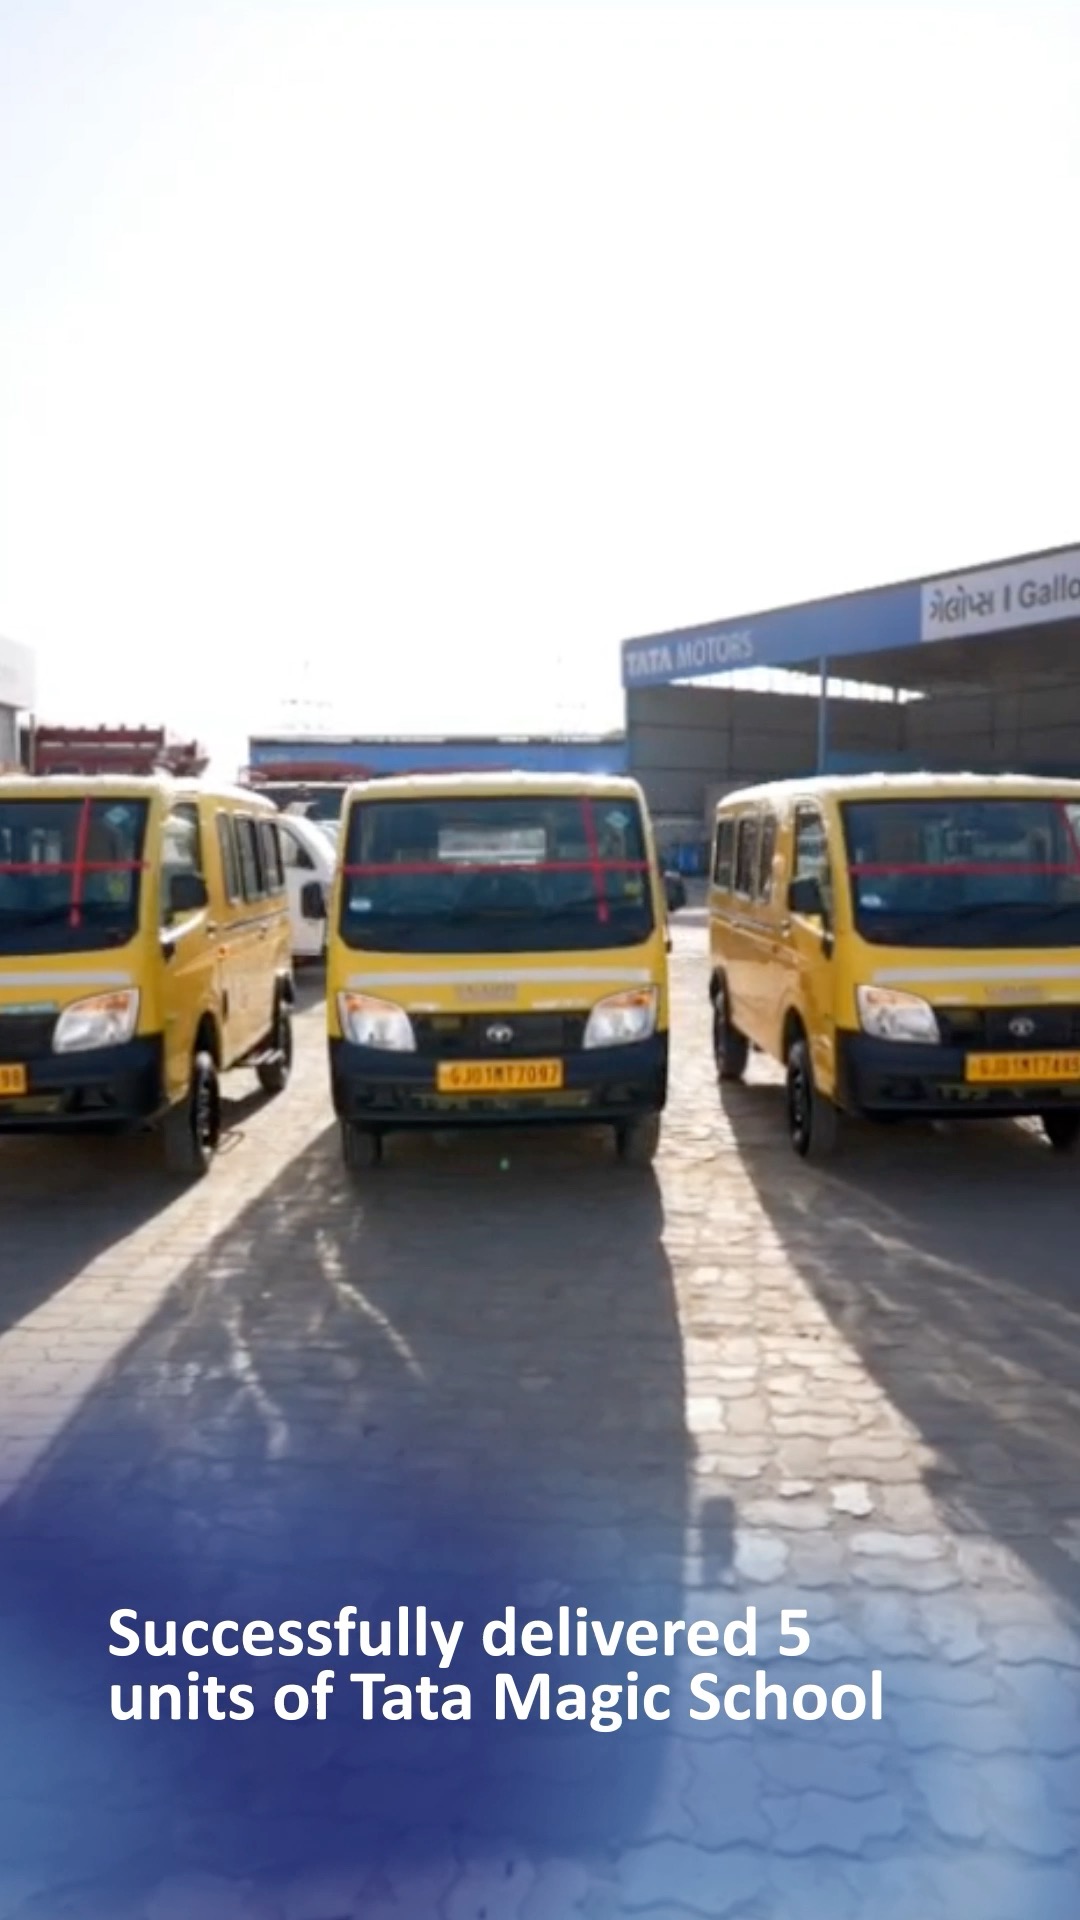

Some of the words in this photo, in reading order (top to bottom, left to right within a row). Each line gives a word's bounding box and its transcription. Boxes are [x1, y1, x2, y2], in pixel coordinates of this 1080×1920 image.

[1018, 573, 1080, 609] Gallo
[626, 645, 672, 676] TATA
[676, 630, 753, 670] MOTORS
